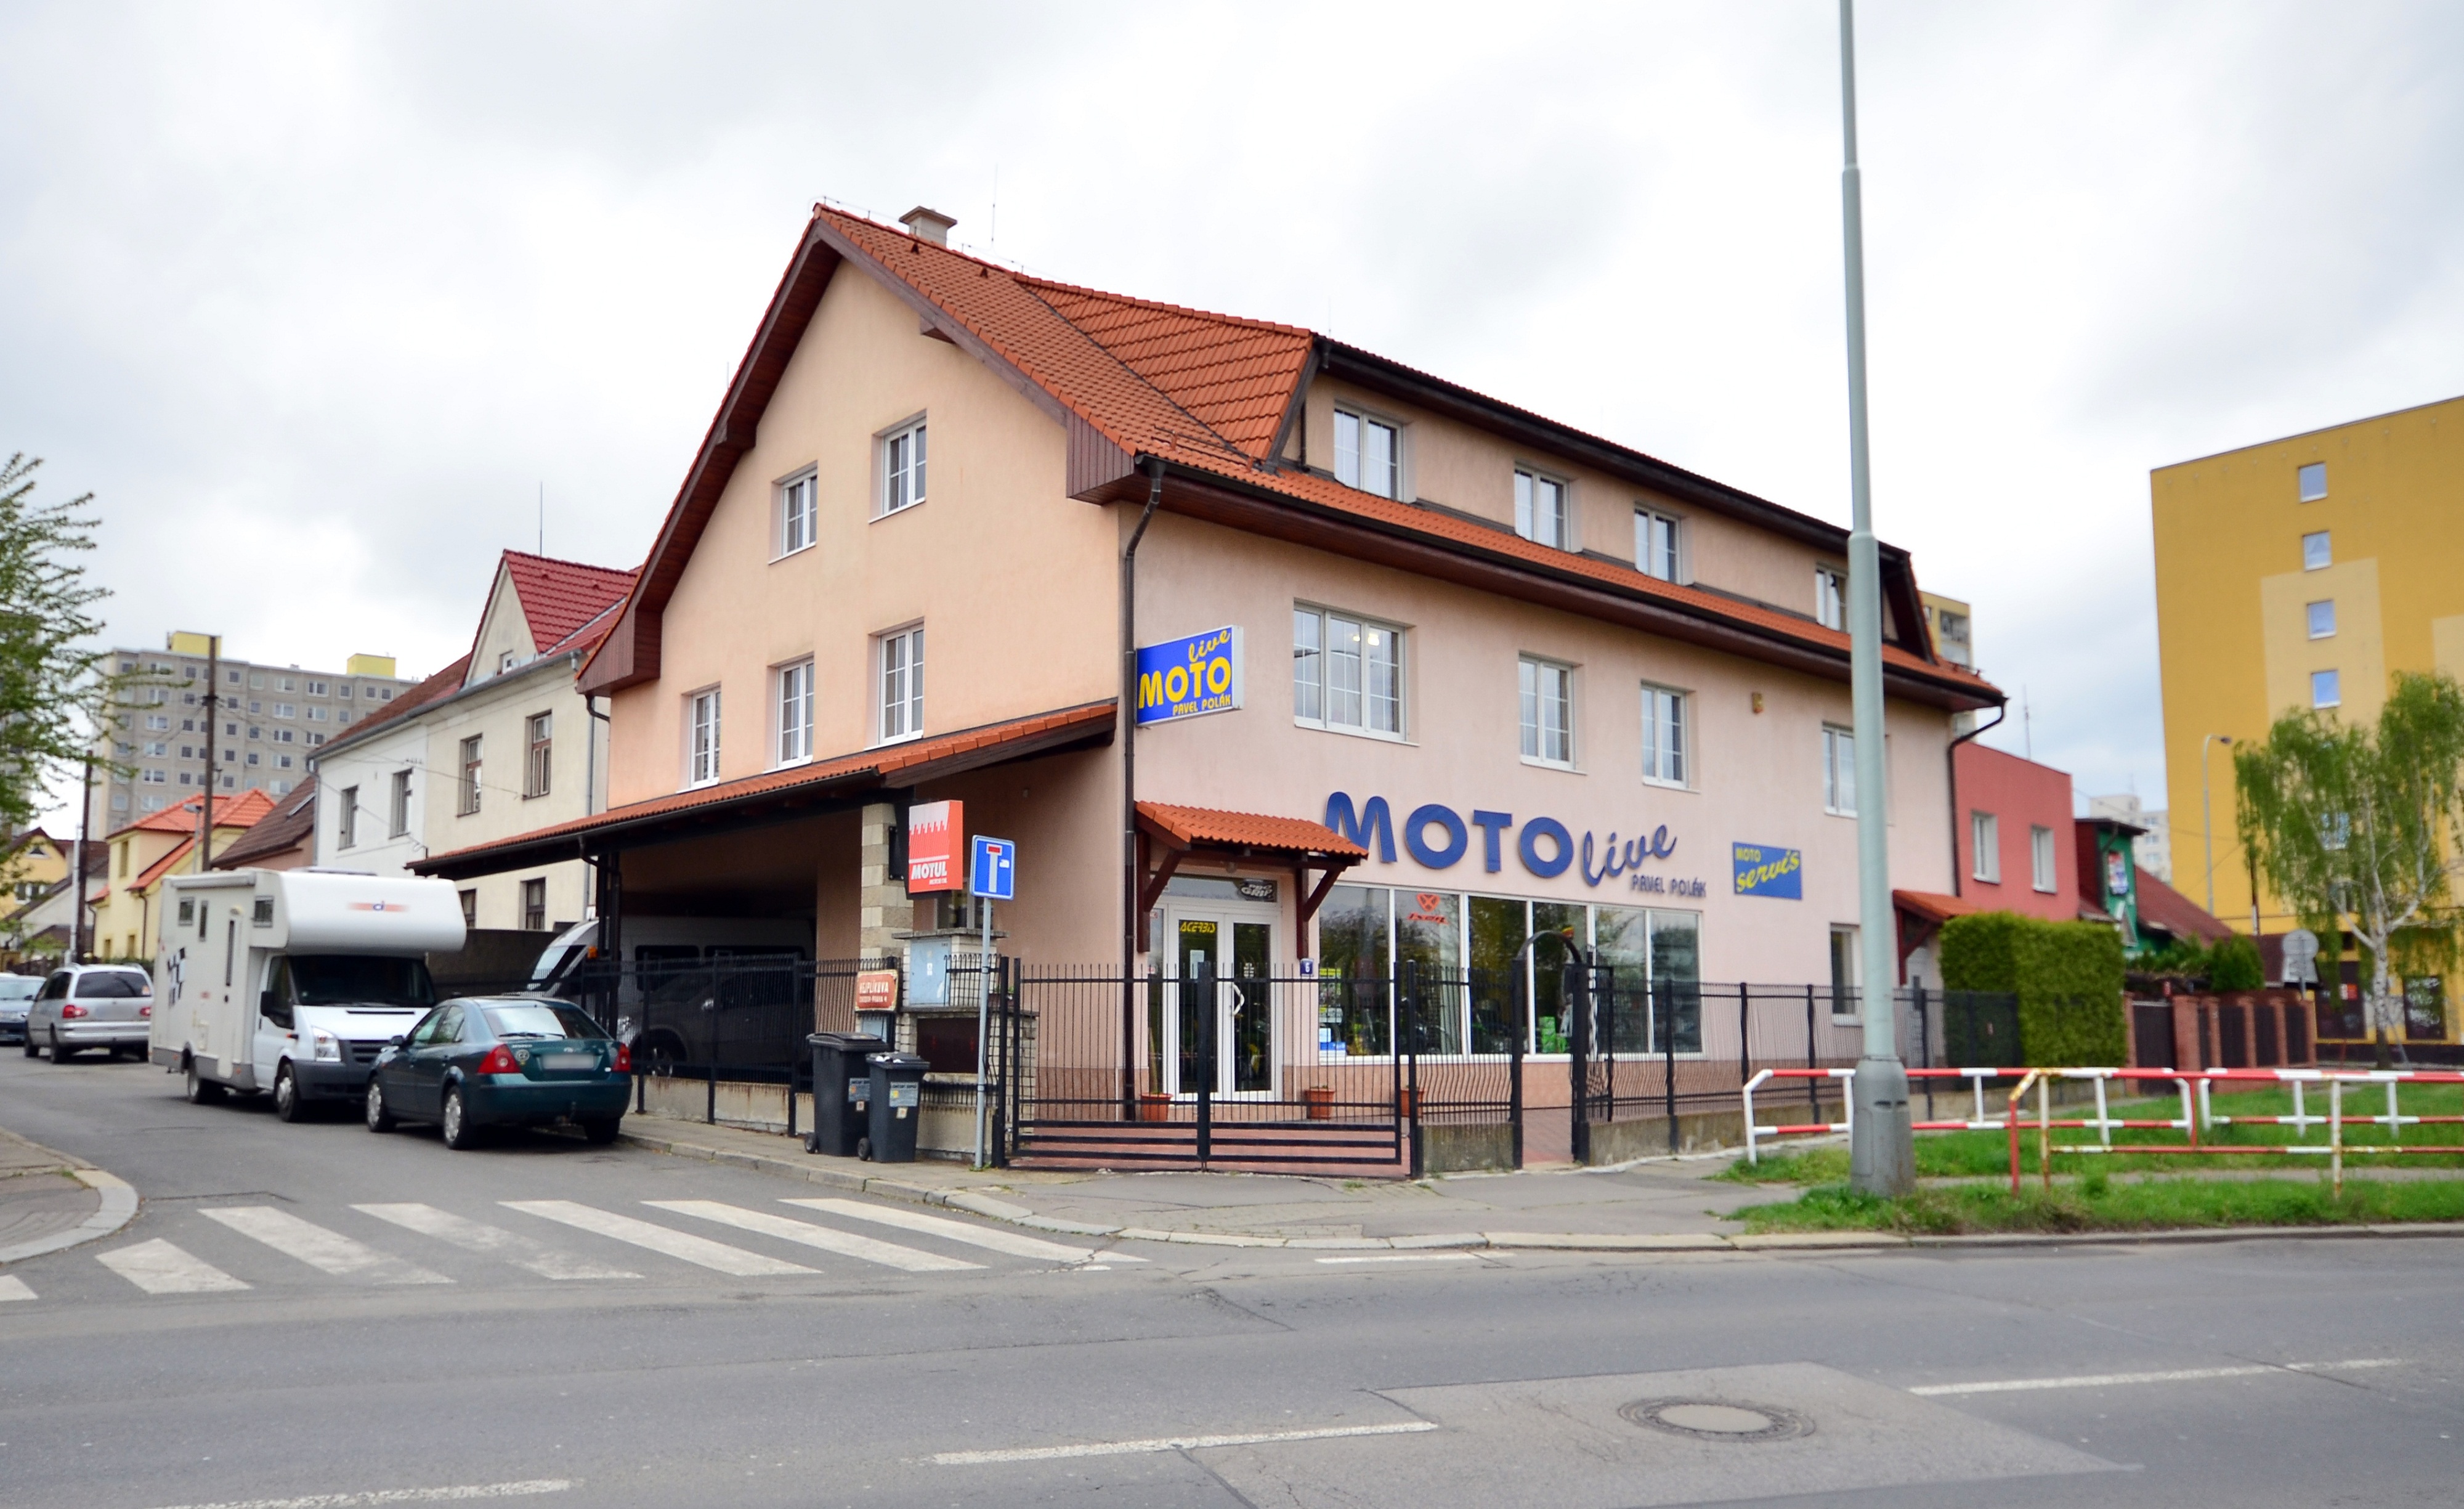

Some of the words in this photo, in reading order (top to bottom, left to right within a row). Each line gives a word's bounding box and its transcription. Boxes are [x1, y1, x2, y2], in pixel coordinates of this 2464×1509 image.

[1188, 630, 1231, 662] live
[1138, 656, 1231, 709] MOTO
[1172, 701, 1198, 716] PAVEL
[1202, 694, 1231, 710] POLÁK
[1324, 791, 1574, 878] MOTO
[1582, 824, 1677, 887] live
[911, 861, 947, 881] MOTUL
[1241, 887, 1273, 897] GRIP
[1631, 874, 1664, 893] PAVEL
[1669, 877, 1706, 897] POLÁK
[1180, 921, 1216, 933] ACERBIS
[1305, 962, 1310, 973] 6
